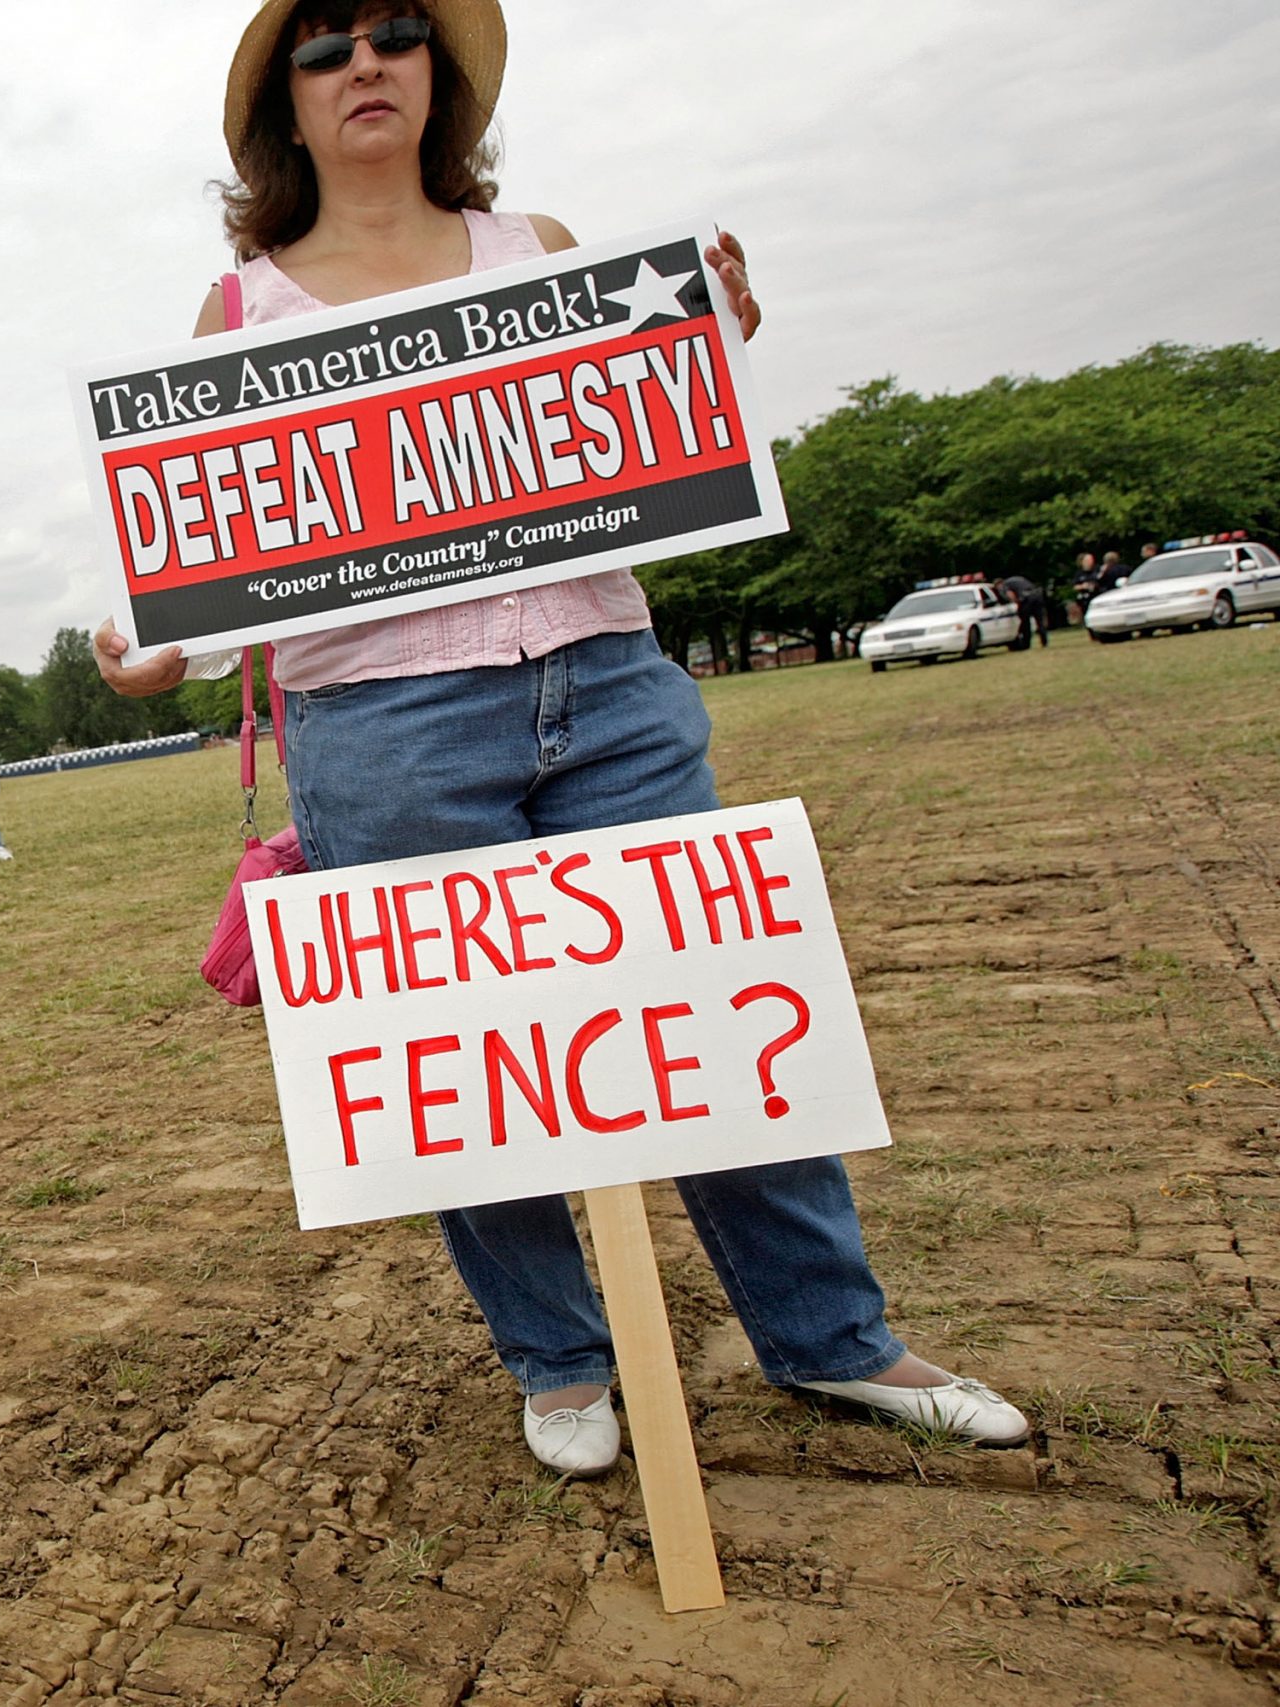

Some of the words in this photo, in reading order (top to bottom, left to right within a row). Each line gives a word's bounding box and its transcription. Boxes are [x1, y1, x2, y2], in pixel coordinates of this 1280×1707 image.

[93, 371, 221, 437] Take
[235, 325, 448, 412] America
[455, 273, 606, 343] Back!
[116, 418, 364, 578] DEFEAT
[390, 334, 734, 525] AMNESTY!
[247, 570, 333, 602] “Cover
[337, 560, 378, 586] the
[382, 529, 500, 574] Country”
[505, 504, 640, 544] Campaign
[350, 555, 524, 600] www.defeatamnesty.org
[265, 850, 623, 1007] WHERE'S
[622, 826, 803, 952] THE
